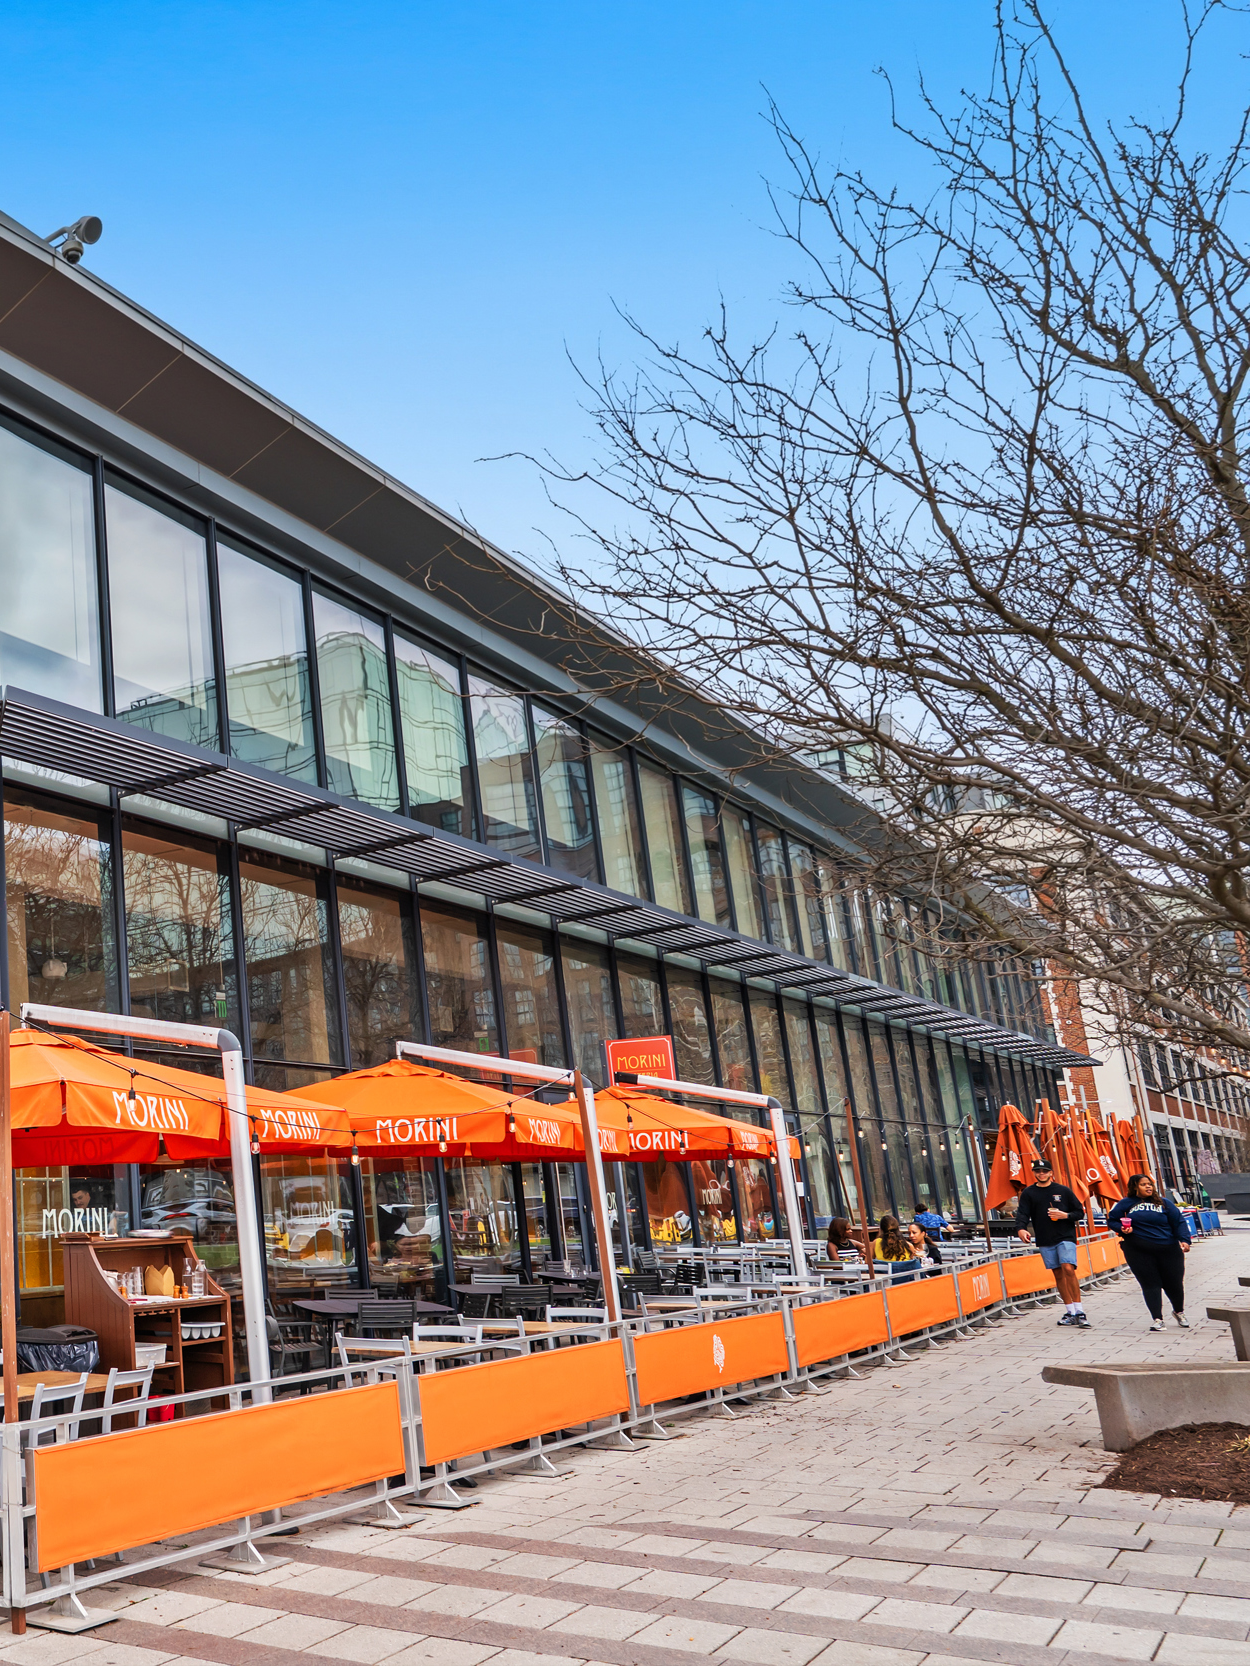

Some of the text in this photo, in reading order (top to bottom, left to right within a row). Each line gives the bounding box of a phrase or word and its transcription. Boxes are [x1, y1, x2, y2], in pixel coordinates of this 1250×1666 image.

[617, 1054, 666, 1070] MORINI
[112, 1091, 189, 1130] MORINI
[260, 1109, 321, 1140] MORINI
[376, 1117, 459, 1143] MORINI
[528, 1118, 561, 1145] MORINI
[42, 1207, 108, 1239] MORINI
